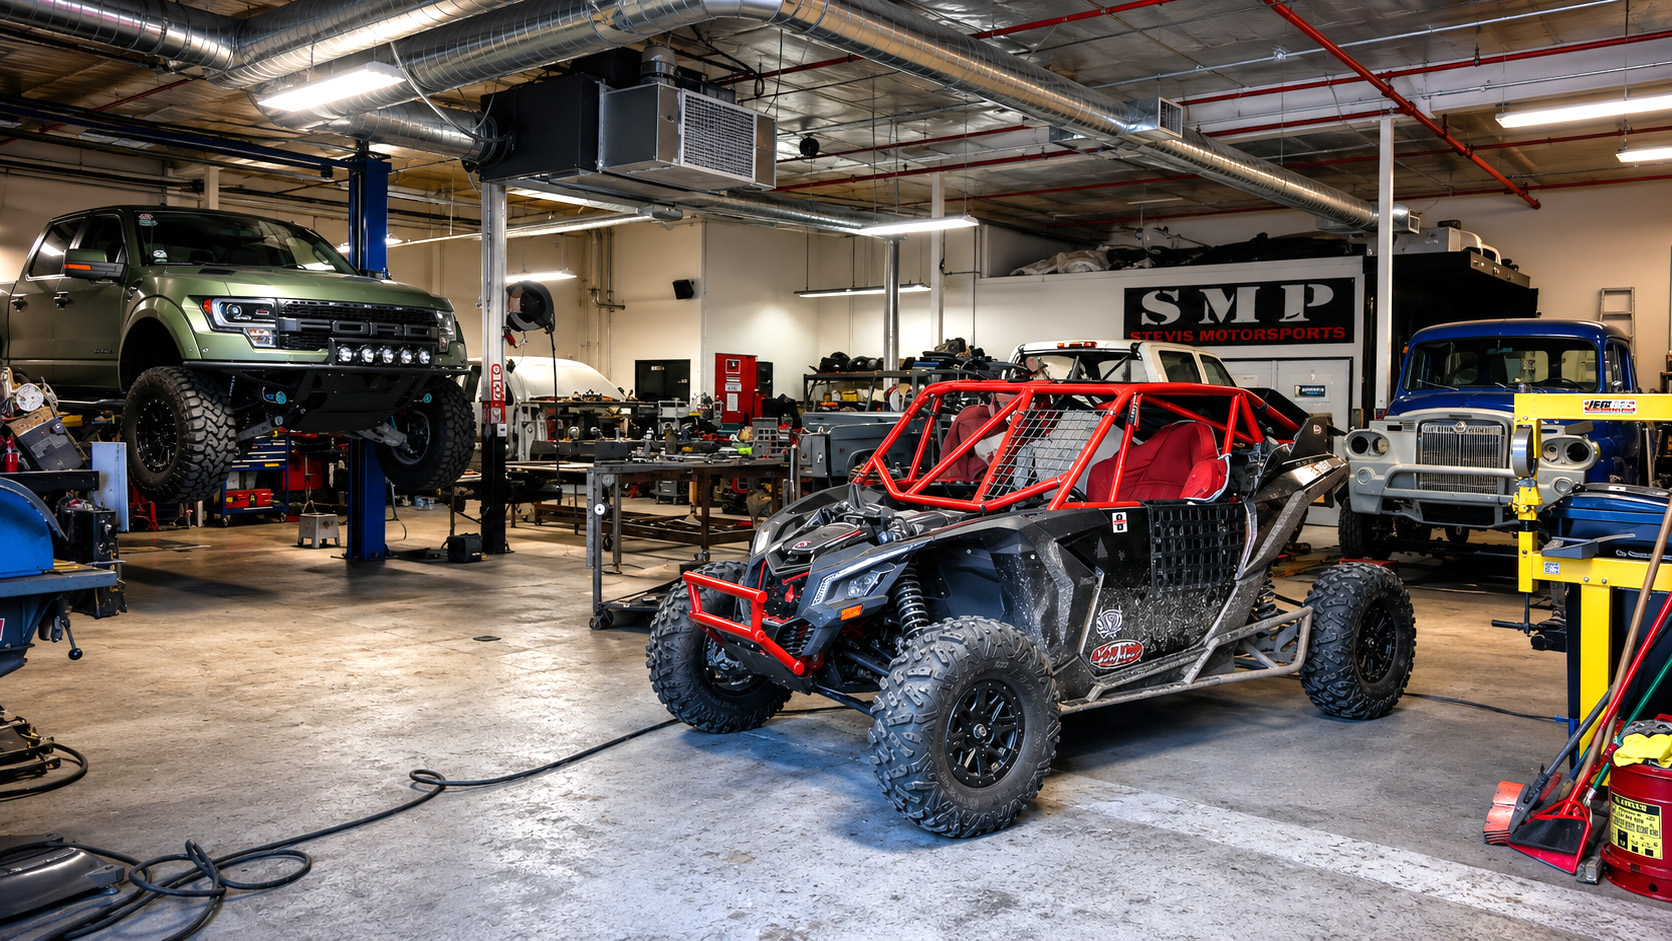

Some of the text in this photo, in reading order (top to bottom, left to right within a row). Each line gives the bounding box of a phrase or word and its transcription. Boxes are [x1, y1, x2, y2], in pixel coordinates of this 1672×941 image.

[1141, 284, 1334, 326] SMP
[297, 318, 432, 337] FORD
[1130, 327, 1346, 342] STEVIS MOTORSPORTS
